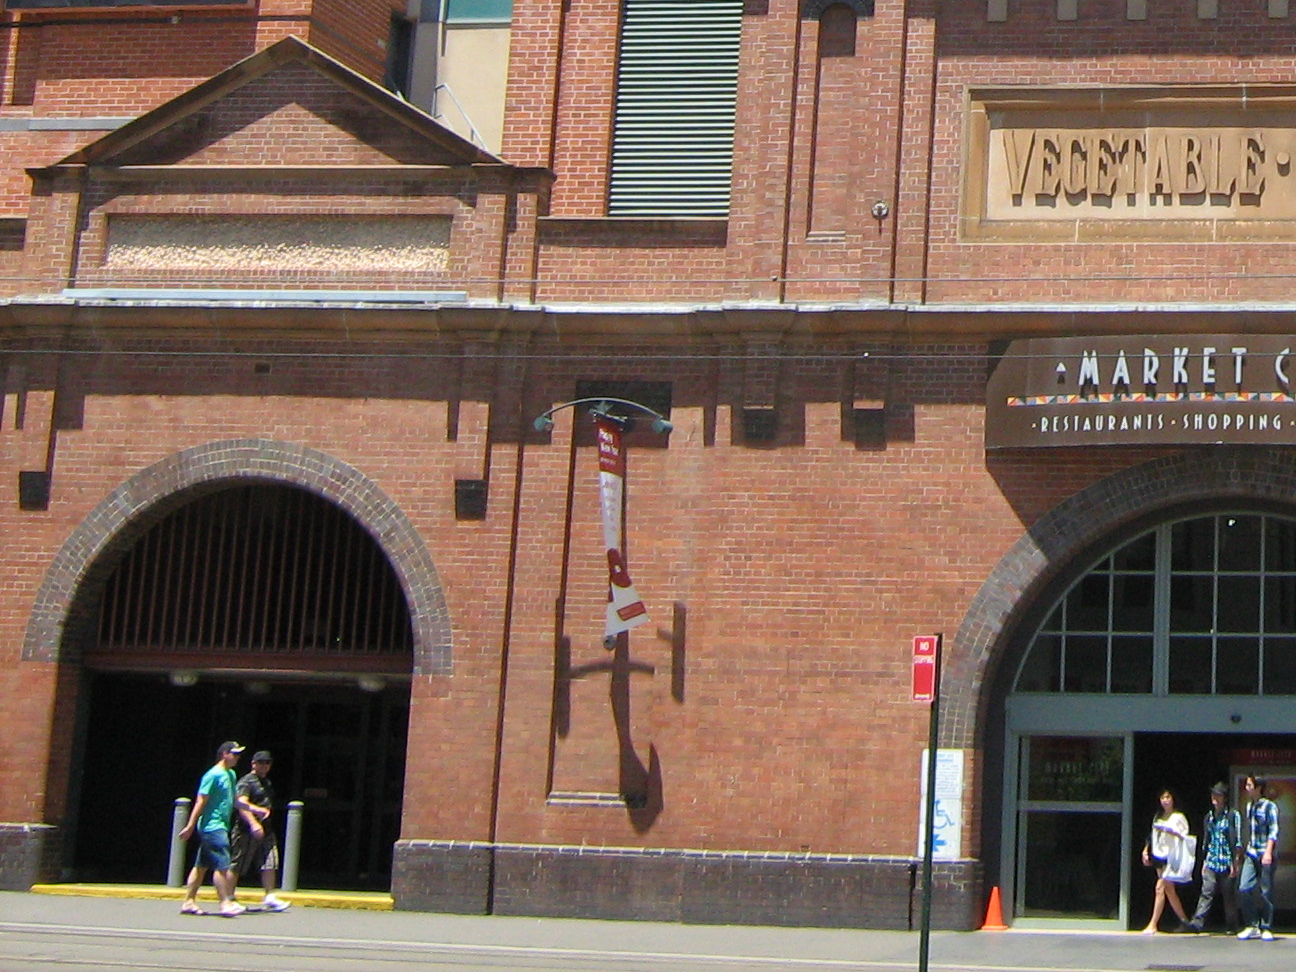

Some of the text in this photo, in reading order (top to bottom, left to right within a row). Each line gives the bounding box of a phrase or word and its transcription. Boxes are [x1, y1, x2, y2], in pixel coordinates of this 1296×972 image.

[1001, 129, 1268, 201] VEGETABLE
[1078, 347, 1247, 385] MARKET
[1040, 413, 1164, 433] RESTAURANTS
[1183, 413, 1282, 430] SHOPPING
